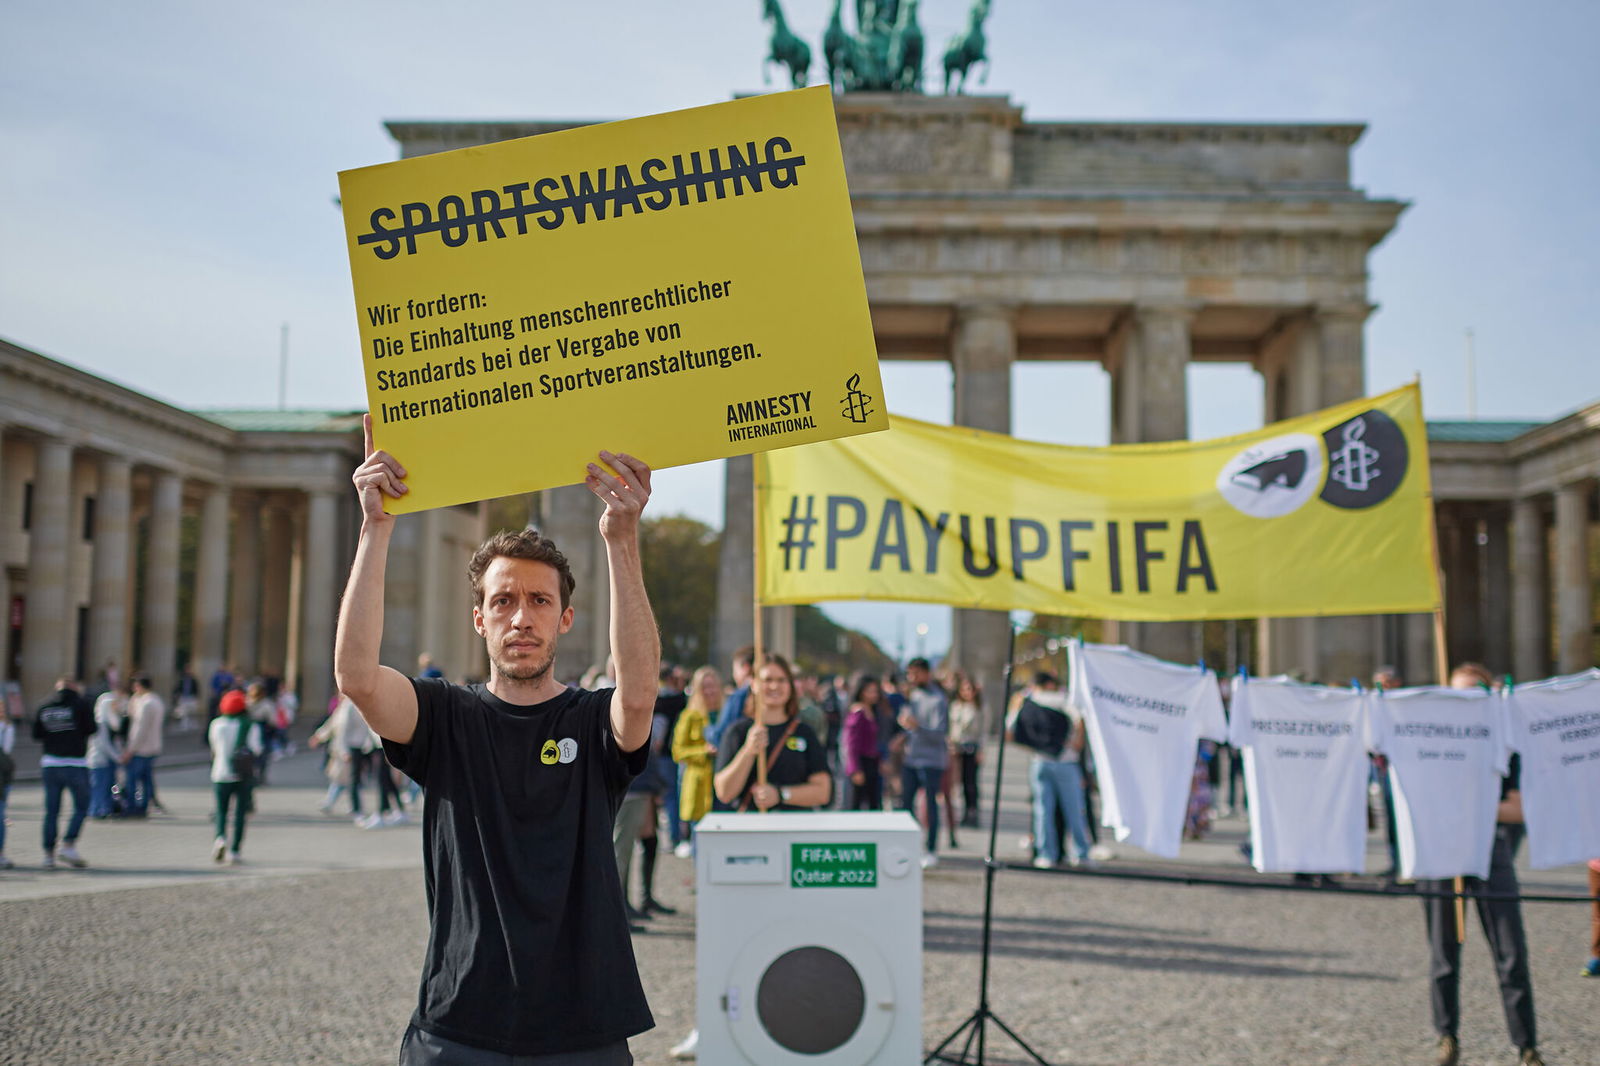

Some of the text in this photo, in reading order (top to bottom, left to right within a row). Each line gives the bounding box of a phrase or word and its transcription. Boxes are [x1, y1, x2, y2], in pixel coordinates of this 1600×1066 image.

[366, 136, 801, 260] SPORTSWASHING
[368, 292, 487, 327] Wir fordern:
[373, 281, 732, 359] Die Einhaltung menschenrechtlicher
[377, 322, 681, 391] Standards bei der Vergabe von
[382, 343, 762, 423] Internationalen Sportveranstaltungen.
[726, 390, 812, 426] AMNESTY
[728, 416, 817, 442] INTERNATIONAL
[779, 494, 1219, 593] #PAYUPFIFA
[793, 868, 875, 886] Qatar 2022
[800, 848, 867, 863] FIFA-WM
